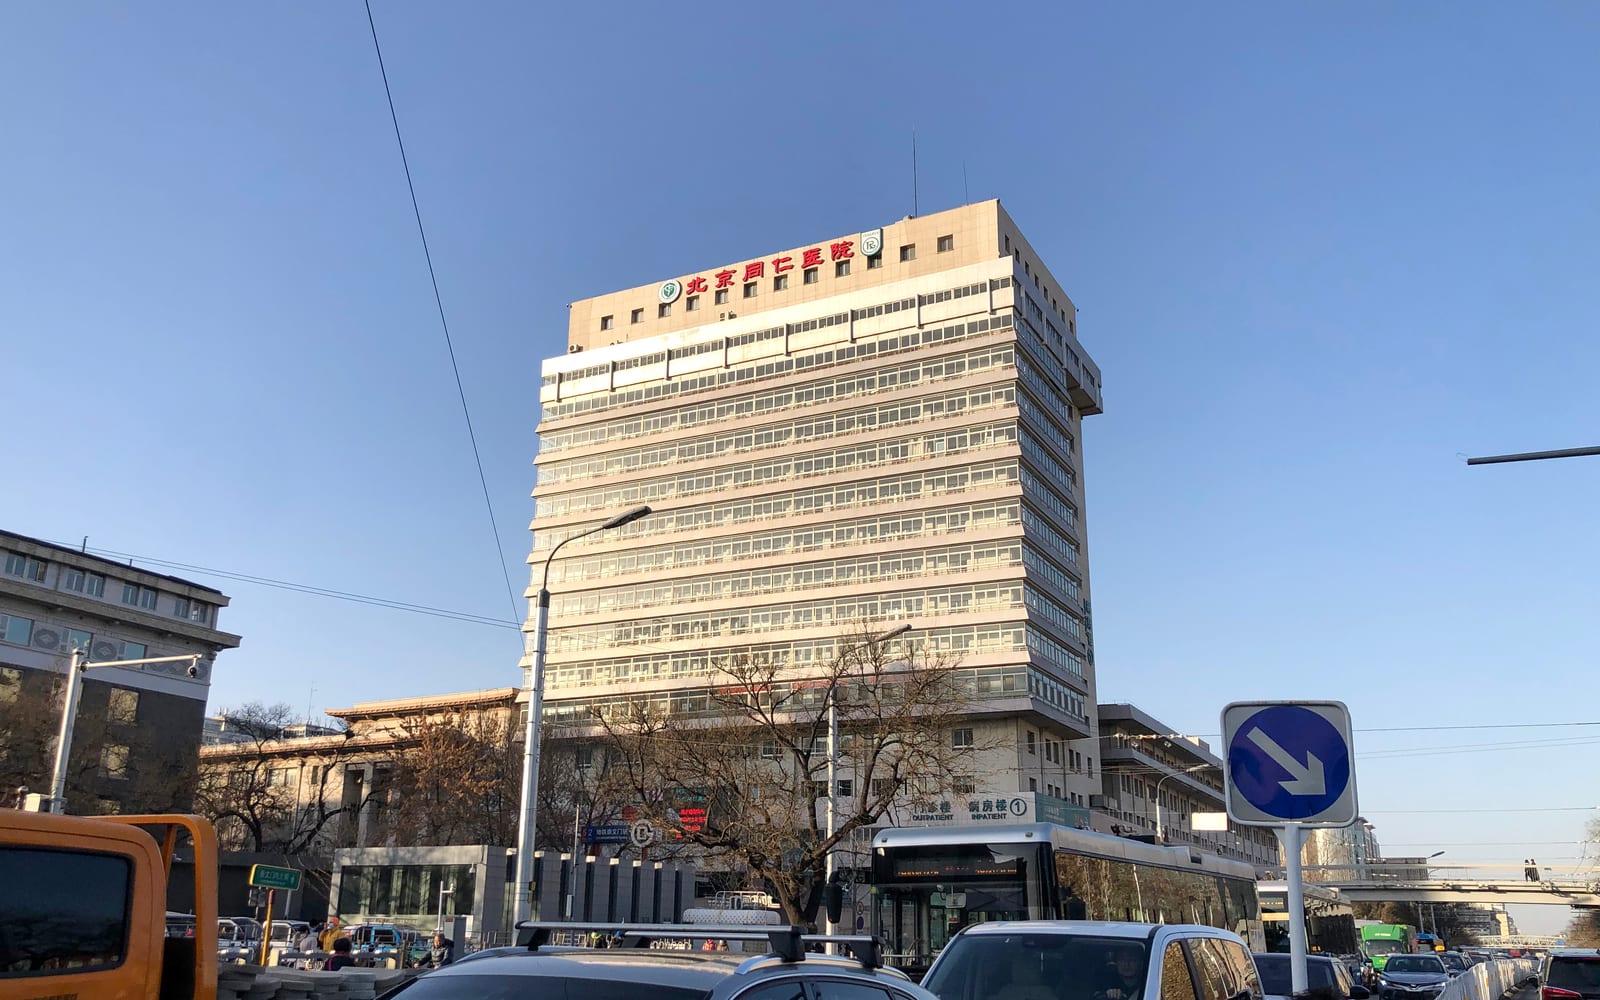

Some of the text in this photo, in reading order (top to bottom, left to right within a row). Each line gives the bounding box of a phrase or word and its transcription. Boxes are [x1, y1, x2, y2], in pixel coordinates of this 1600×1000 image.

[686, 241, 854, 295] 北京同仁医院
[968, 799, 1007, 812] 病房楼
